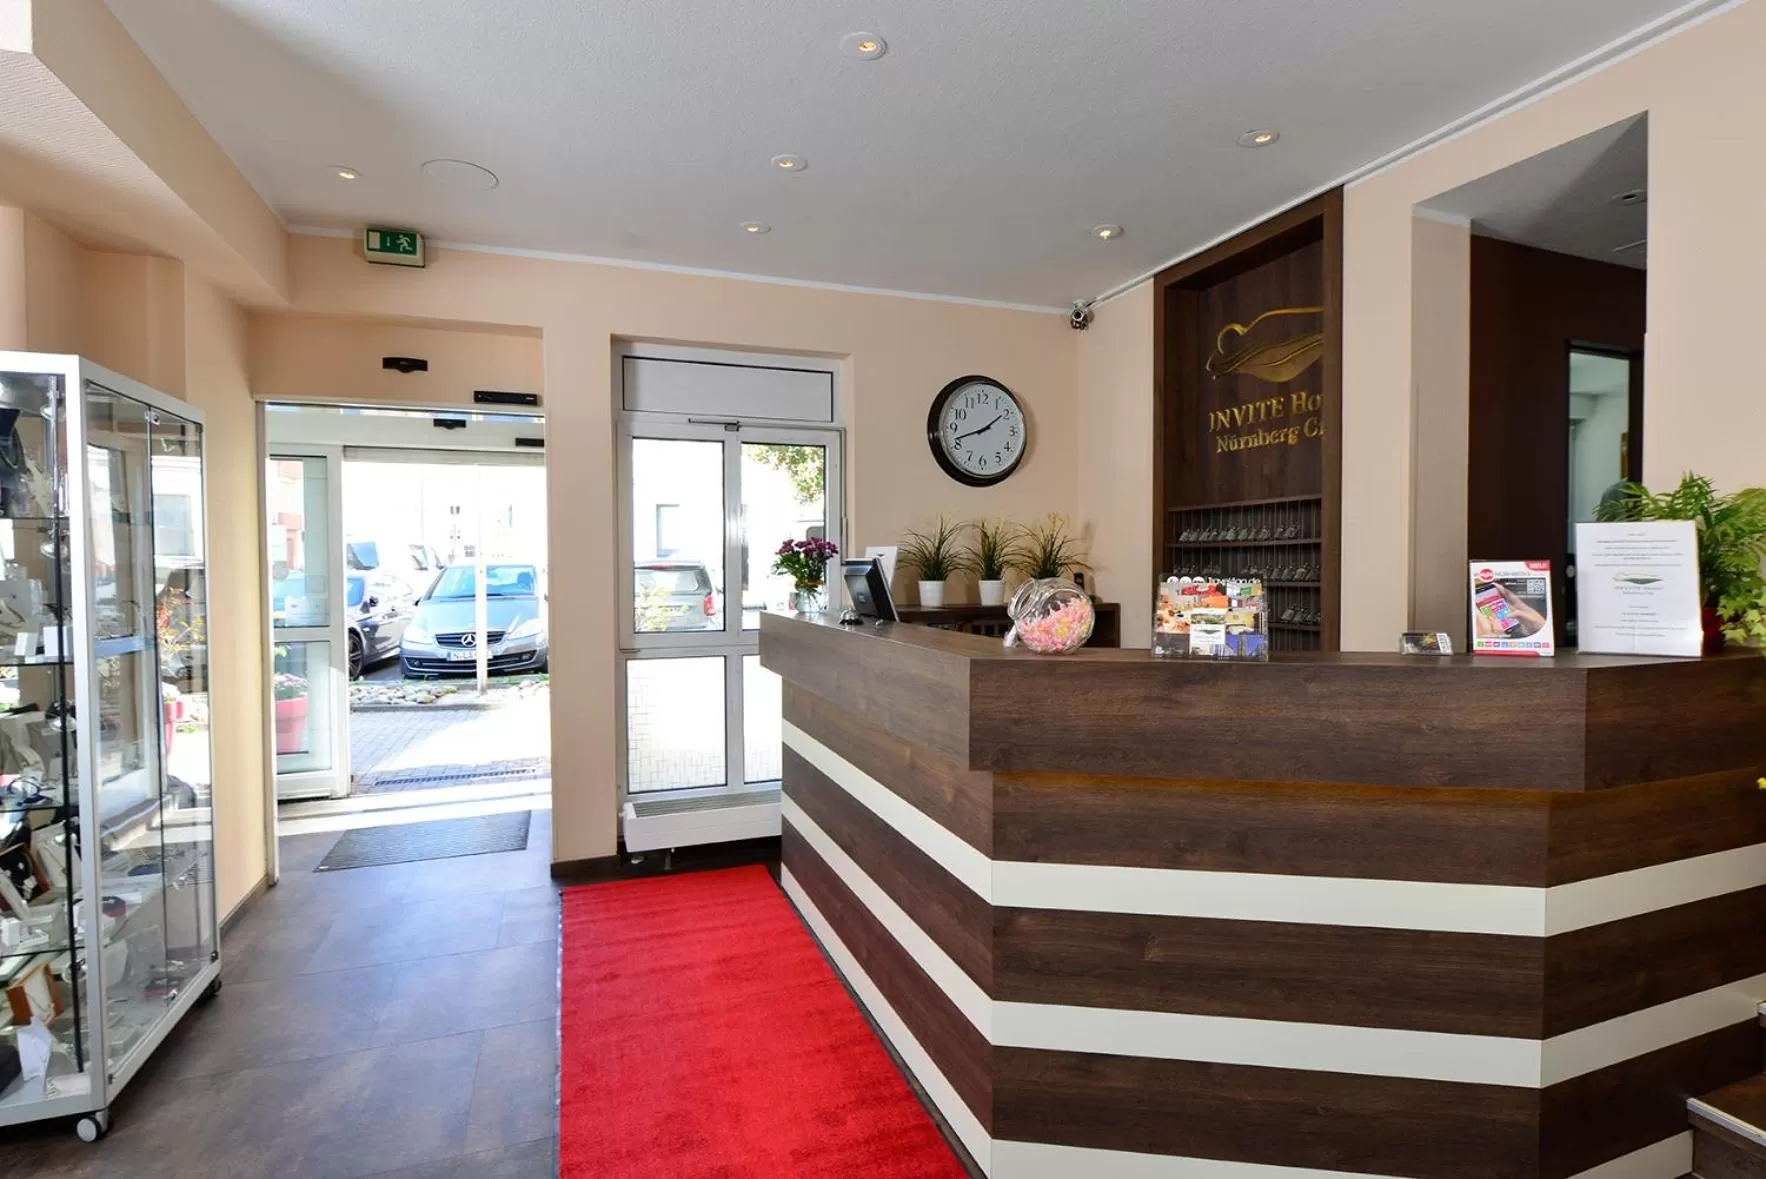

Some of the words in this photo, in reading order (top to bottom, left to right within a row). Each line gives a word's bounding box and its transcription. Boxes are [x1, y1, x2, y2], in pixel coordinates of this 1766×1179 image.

[965, 397, 974, 409] 11
[977, 392, 989, 405] 12
[955, 408, 967, 420] 10
[1002, 409, 1010, 420] 2
[1208, 397, 1284, 433] INVITE
[950, 422, 958, 433] 9
[1009, 426, 1016, 437] 3
[1216, 425, 1300, 453] Nürnberg
[954, 440, 962, 450] 8
[1004, 441, 1011, 452] 4
[966, 450, 974, 461] 7
[978, 455, 987, 467] 6
[995, 452, 1002, 463] 5
